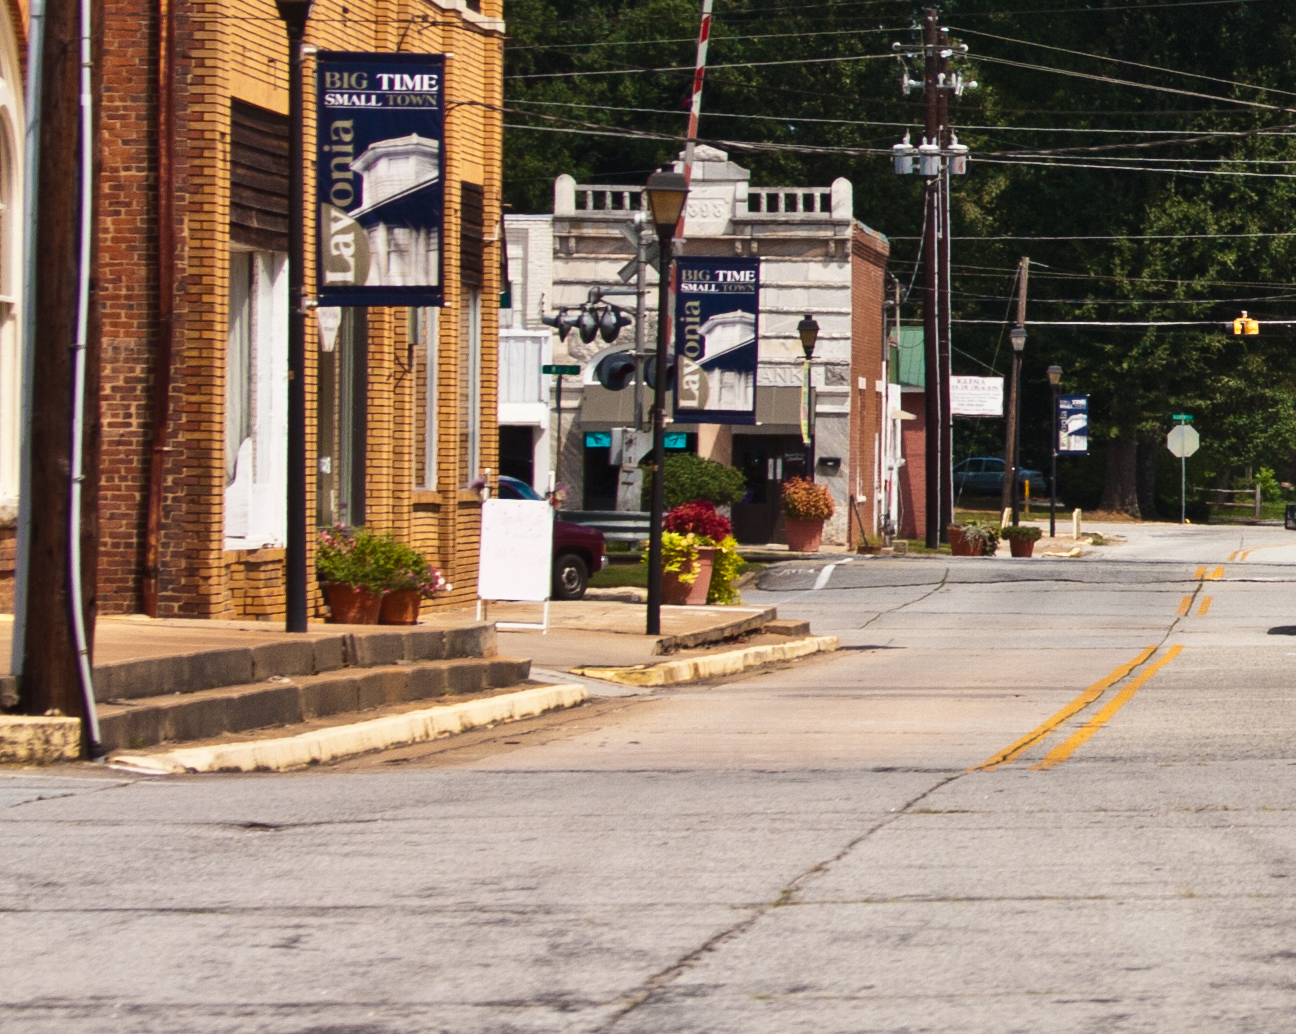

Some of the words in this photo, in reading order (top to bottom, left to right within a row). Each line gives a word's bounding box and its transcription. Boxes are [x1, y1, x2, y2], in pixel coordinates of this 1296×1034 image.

[324, 71, 368, 90] BIG
[376, 73, 439, 91] TIME
[324, 93, 383, 107] SMALL
[386, 94, 437, 106] TOWN
[323, 118, 356, 284] Lavonia
[681, 269, 711, 282] BIG
[715, 270, 756, 282] TIME
[680, 283, 719, 292] SMALL
[722, 284, 755, 292] TOWN
[679, 300, 701, 407] Lavonia
[757, 367, 804, 384] ANK
